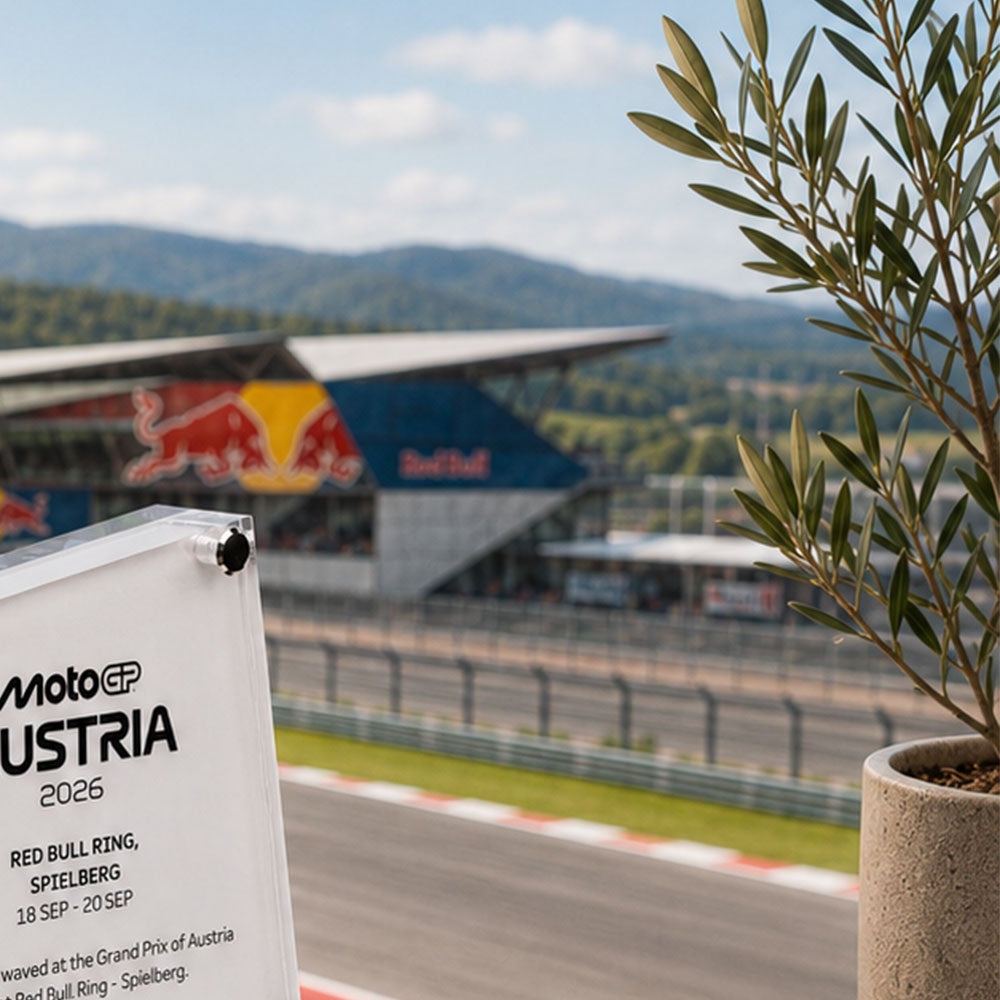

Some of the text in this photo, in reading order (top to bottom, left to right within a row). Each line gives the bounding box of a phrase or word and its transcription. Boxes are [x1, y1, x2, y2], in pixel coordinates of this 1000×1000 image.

[40, 777, 104, 807] 2026
[10, 832, 139, 868] RED BULL RING,
[30, 863, 121, 894] SPIELBERG
[17, 907, 36, 925] 18
[40, 900, 69, 920] SEP
[83, 894, 103, 914] 20
[105, 889, 133, 910] SEP
[1, 958, 49, 983] waved
[51, 957, 67, 975] at
[70, 952, 94, 972] the
[96, 943, 140, 966] Grand
[142, 936, 169, 957] Prix
[170, 933, 186, 952] of
[187, 926, 235, 950] Austria
[77, 976, 109, 999] Ring
[121, 964, 189, 991] Spielberg.
